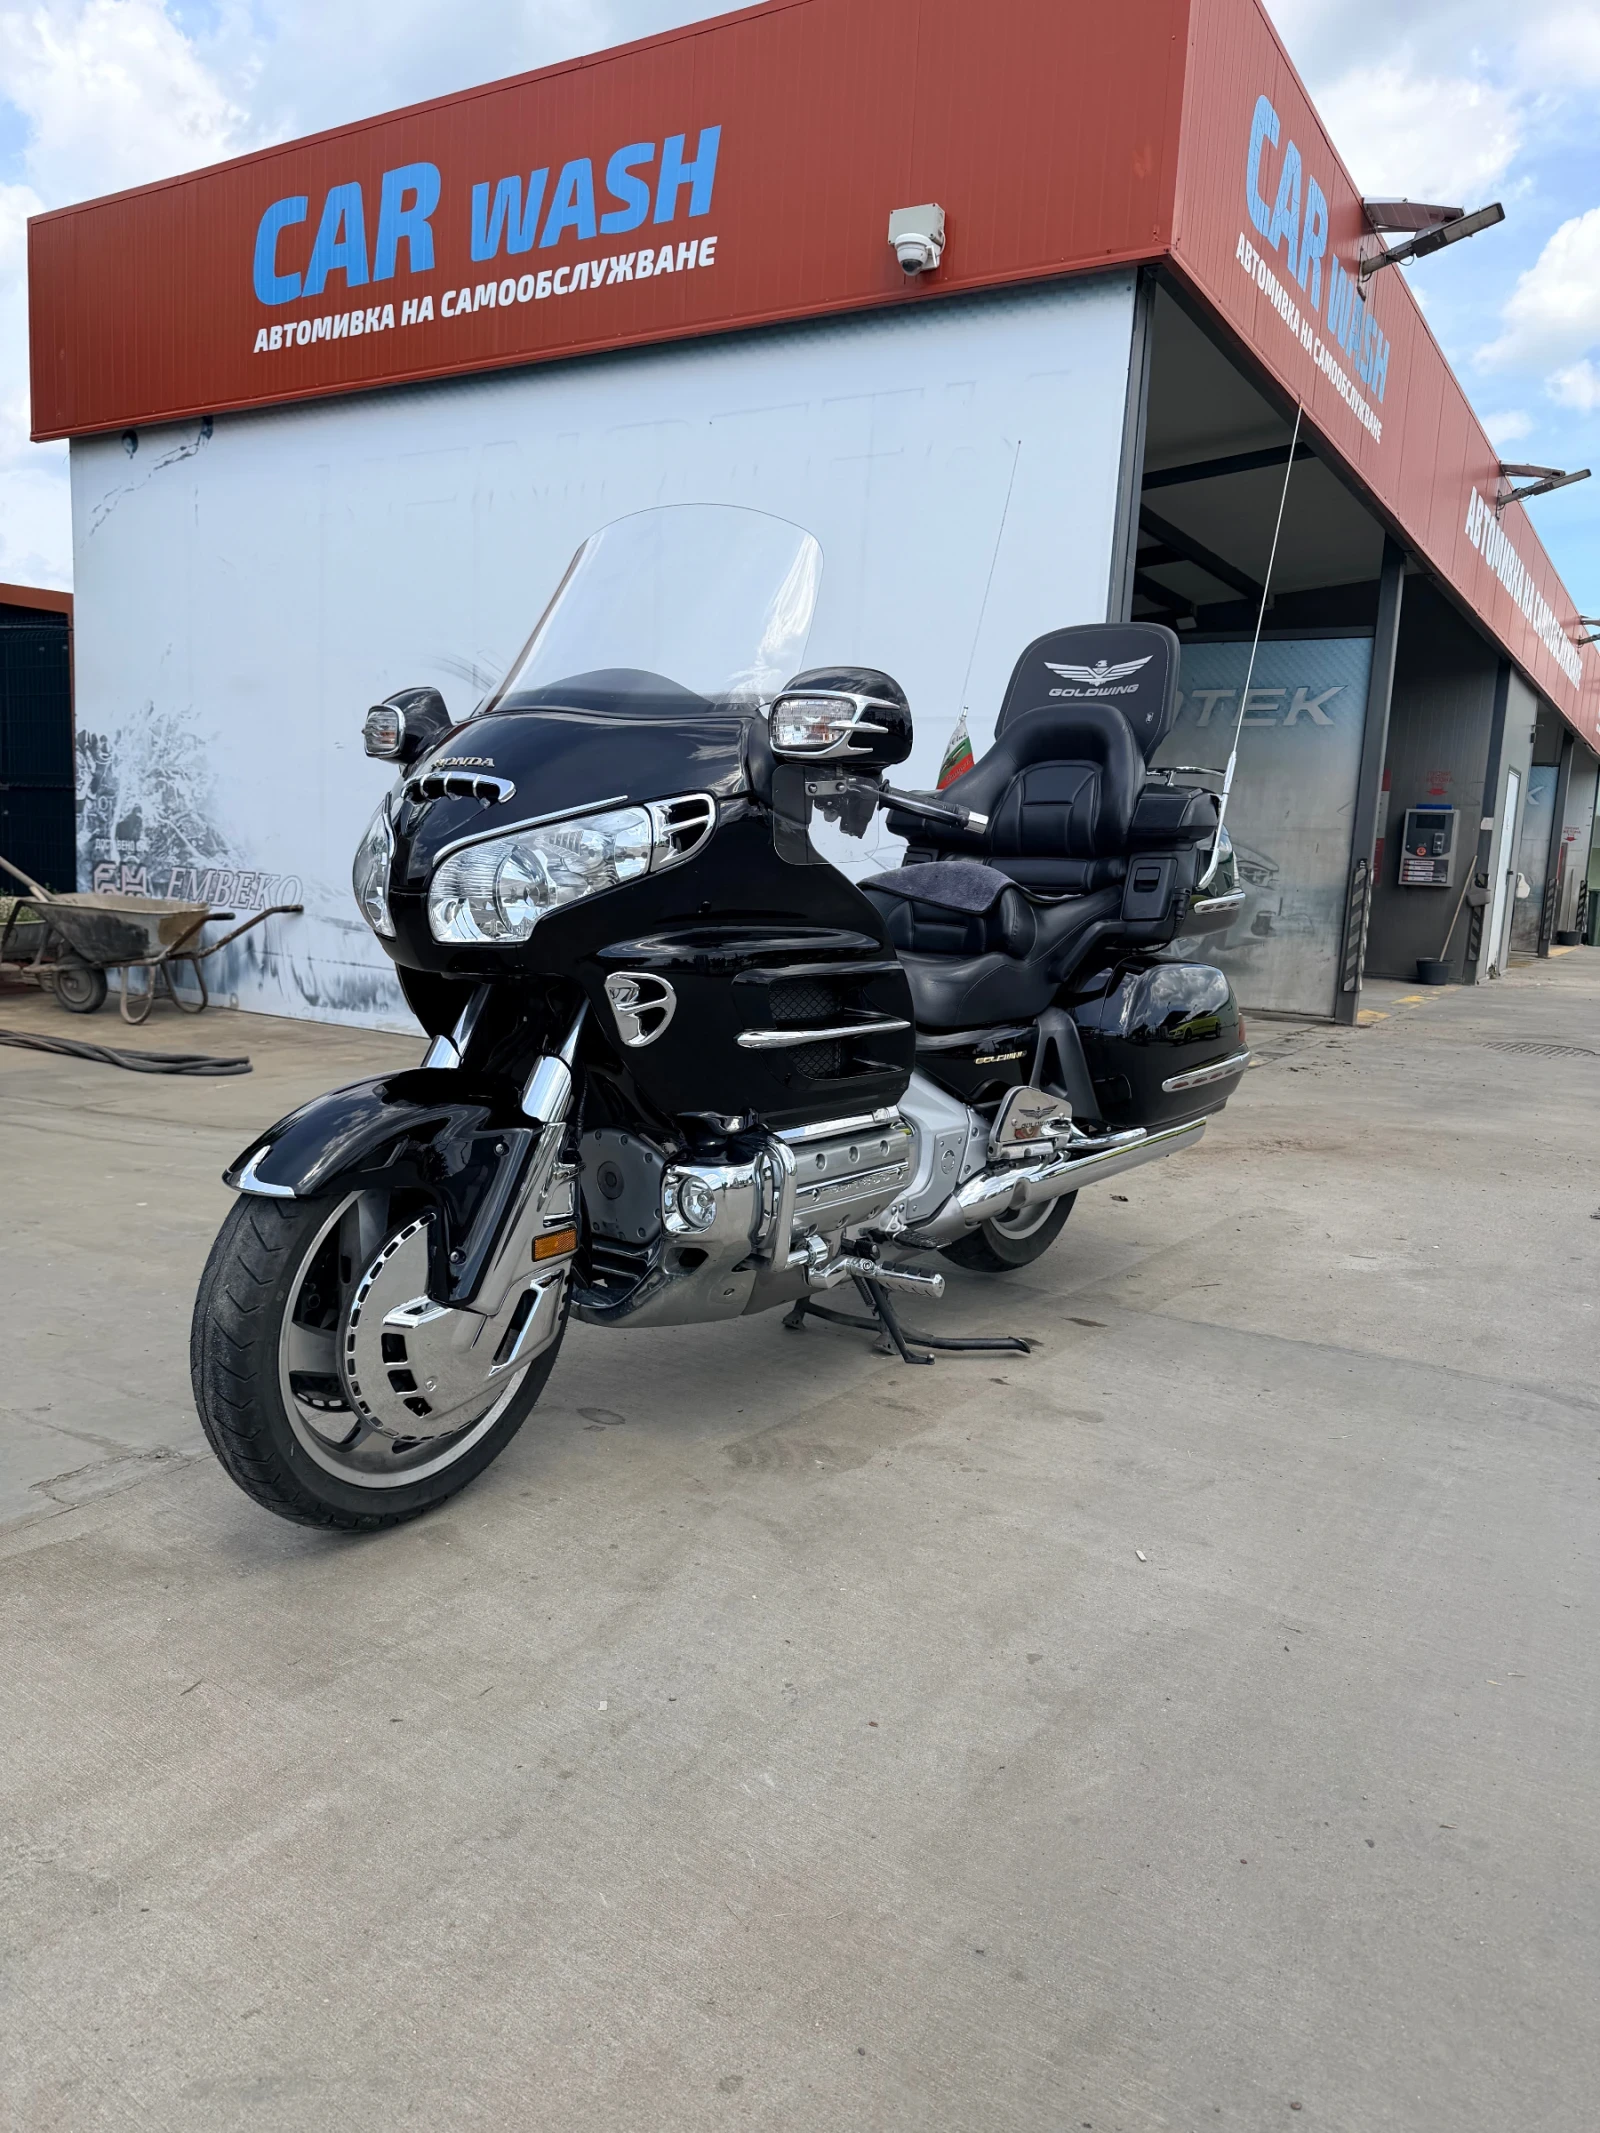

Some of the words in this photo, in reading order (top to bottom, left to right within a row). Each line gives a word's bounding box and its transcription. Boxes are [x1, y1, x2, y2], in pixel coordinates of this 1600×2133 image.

[253, 161, 441, 306] CAR
[469, 125, 722, 262] WASH
[1246, 94, 1328, 313] CAR
[1327, 253, 1390, 404] WASH
[253, 303, 394, 354] АВТОМИВКА
[400, 295, 435, 326] НА
[440, 236, 718, 319] САМООБСЛУЖВАНЕ
[1235, 231, 1301, 339] АВТОМИВКА
[1300, 317, 1314, 356] НА
[1313, 337, 1384, 445] САМООБСЛУЖВАНЕ
[1465, 485, 1526, 608] АВТОМИВКА
[1048, 683, 1140, 697] GOLDWING
[1171, 685, 1348, 728] TEK
[165, 865, 304, 911] EMBEKO
